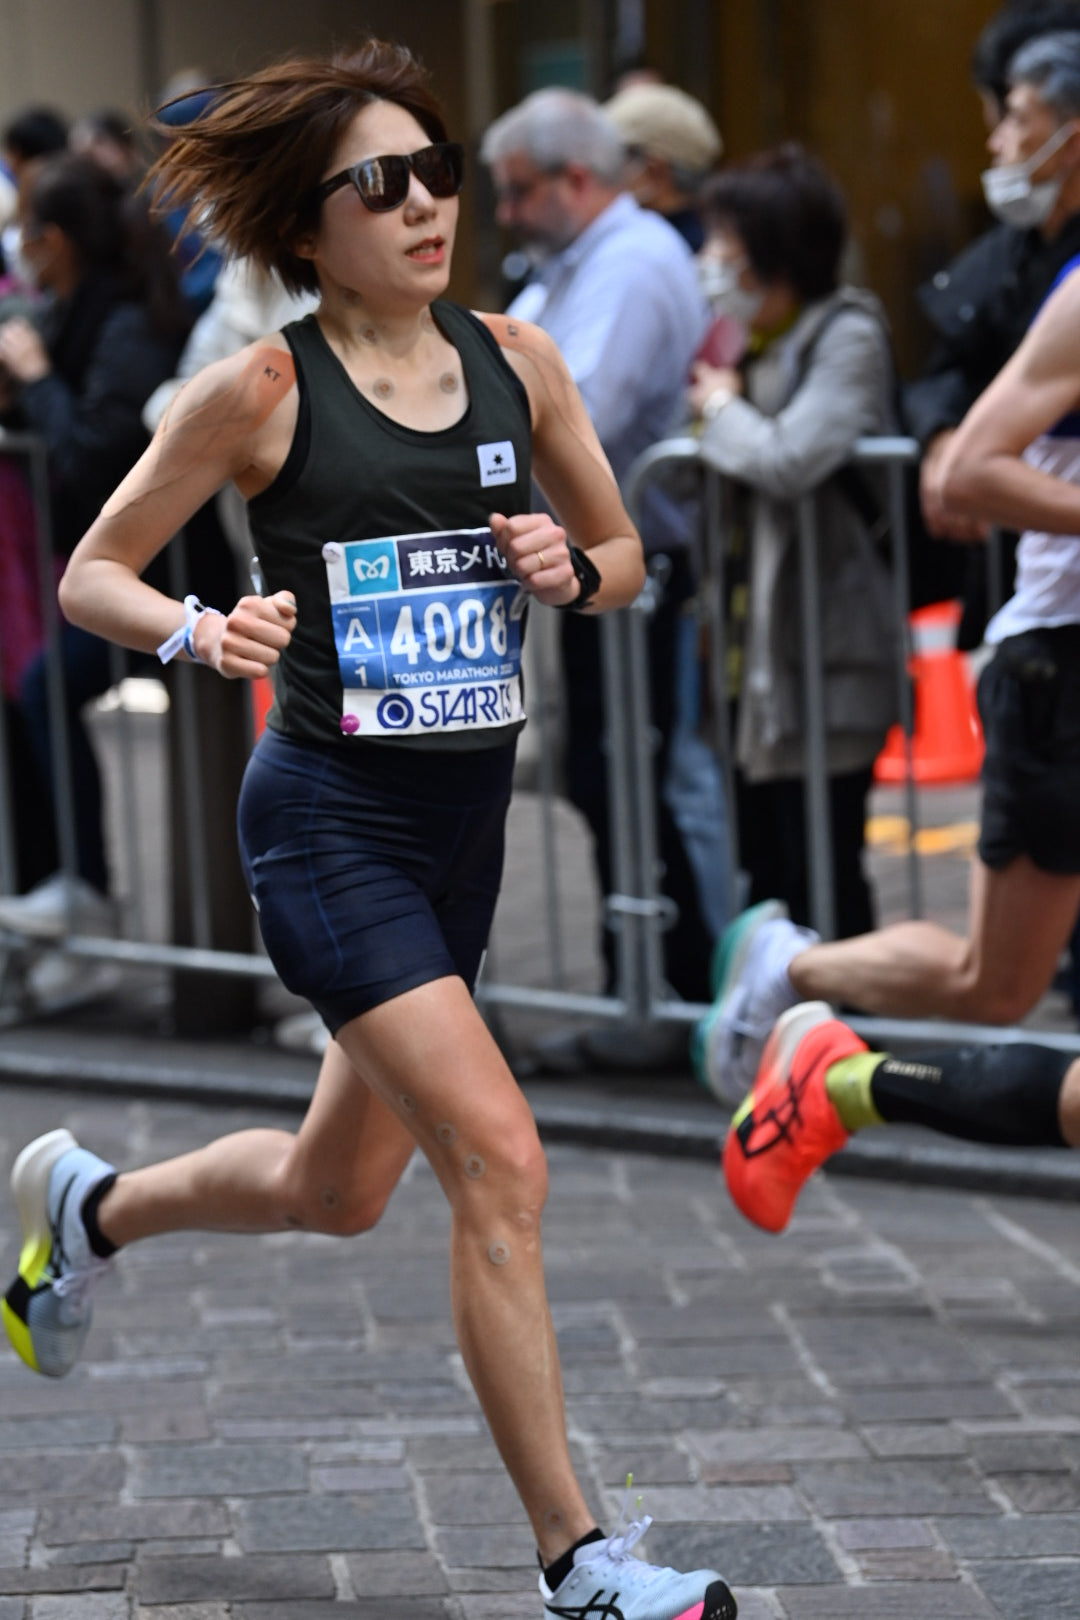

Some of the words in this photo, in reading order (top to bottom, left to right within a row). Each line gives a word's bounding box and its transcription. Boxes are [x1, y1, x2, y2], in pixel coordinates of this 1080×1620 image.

[264, 364, 280, 382] KT
[343, 617, 375, 652] A
[354, 664, 368, 688] 1
[393, 671, 434, 685] TOKYO
[437, 665, 498, 681] MARATHON
